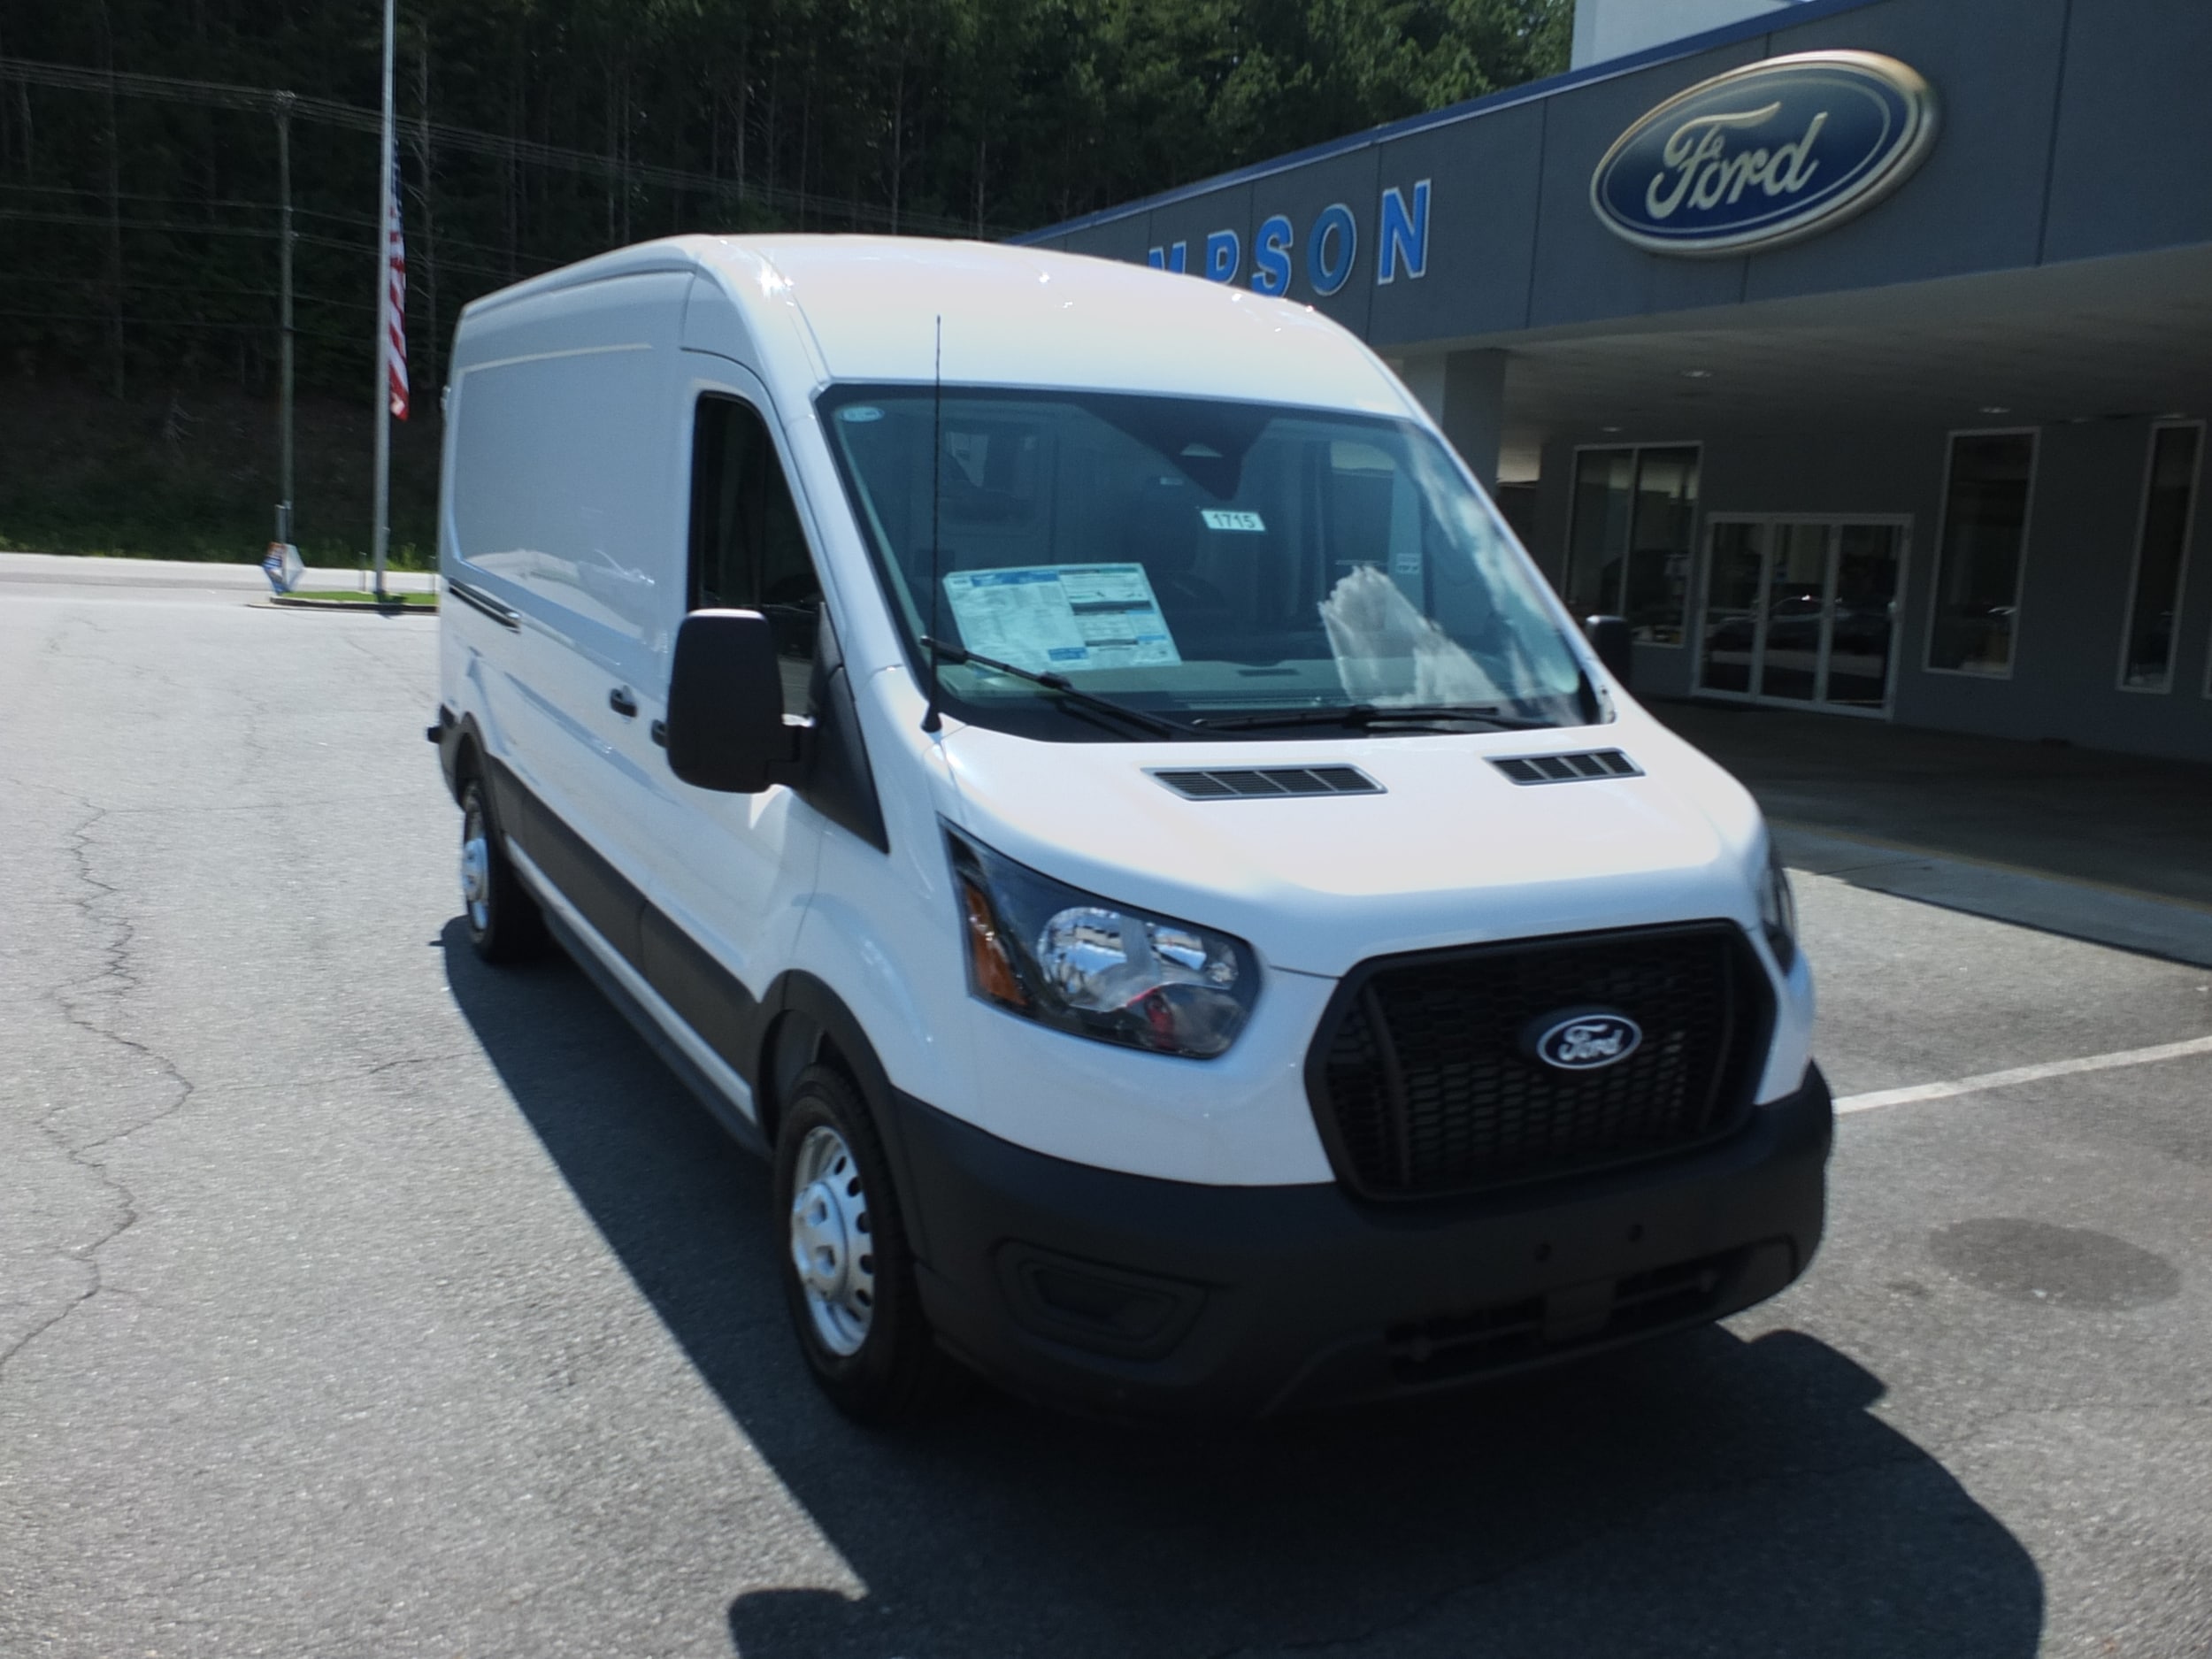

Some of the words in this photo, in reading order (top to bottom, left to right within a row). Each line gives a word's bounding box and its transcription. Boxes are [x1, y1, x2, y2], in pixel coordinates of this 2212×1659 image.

[1646, 101, 1828, 219] Ford
[1213, 513, 1256, 528] 1715
[1558, 1024, 1624, 1061] Ford
